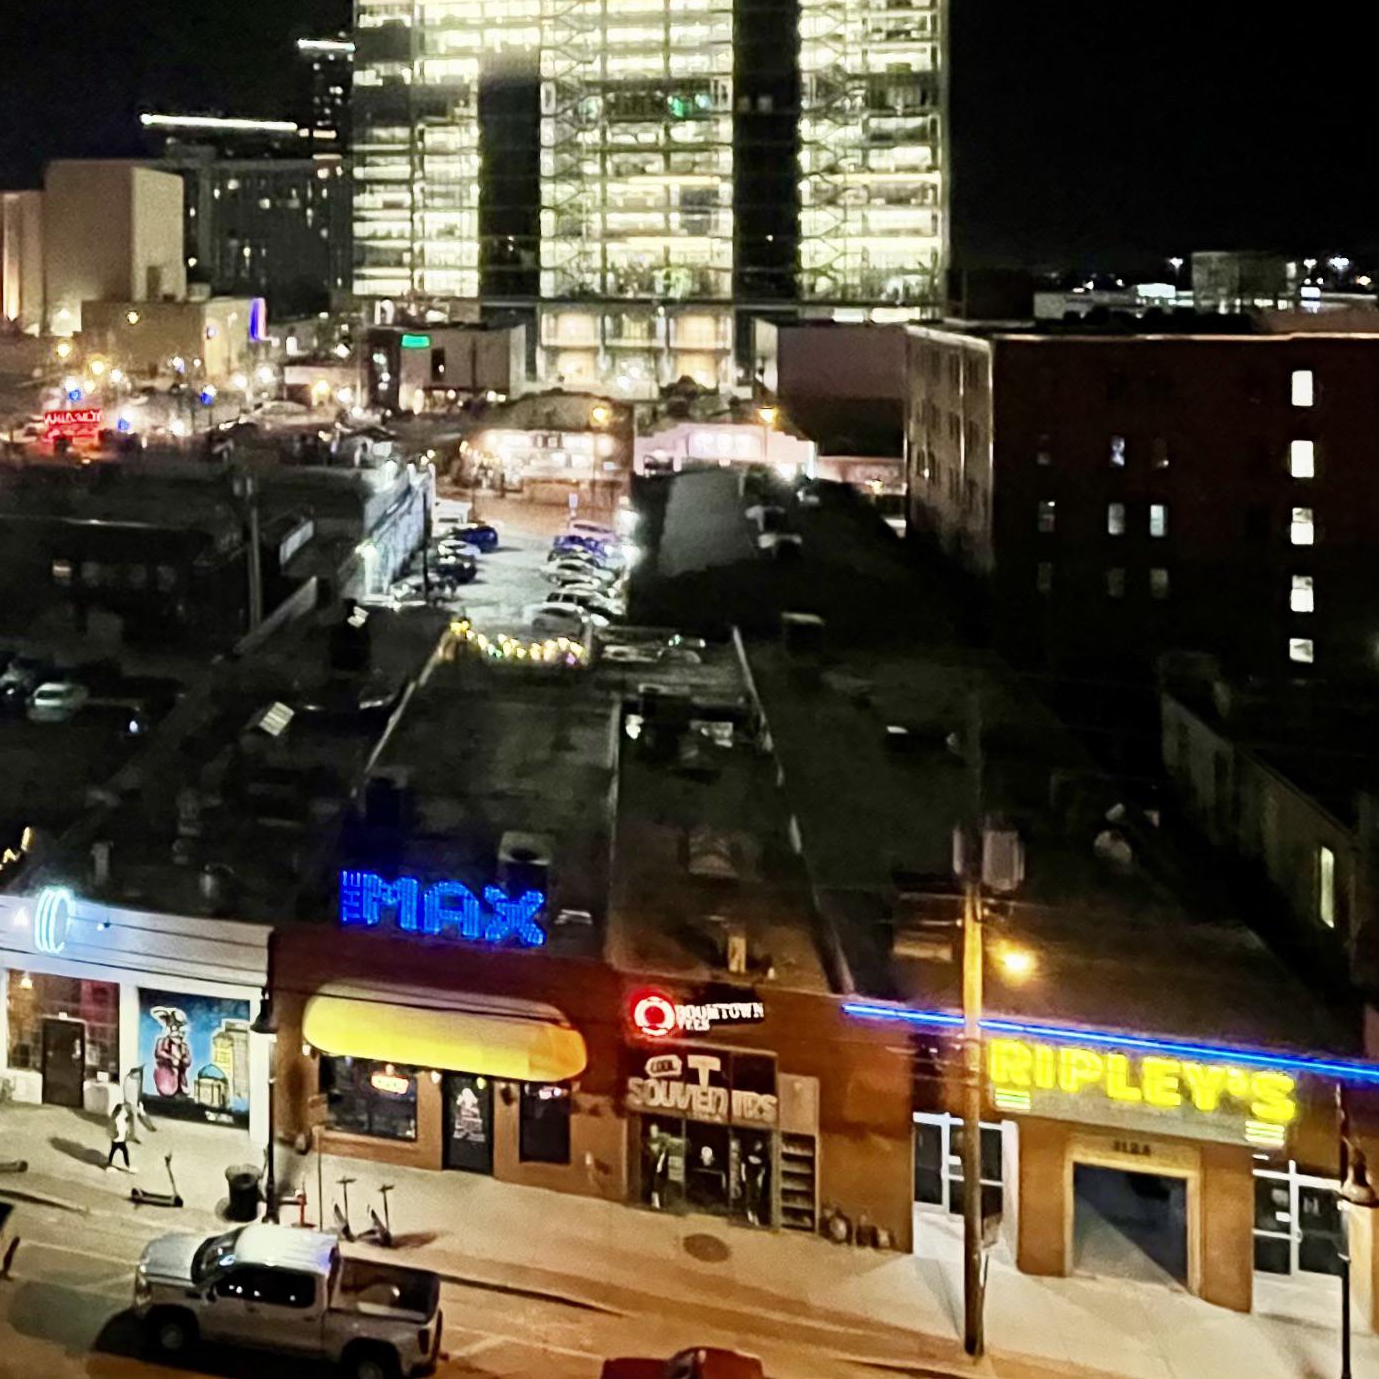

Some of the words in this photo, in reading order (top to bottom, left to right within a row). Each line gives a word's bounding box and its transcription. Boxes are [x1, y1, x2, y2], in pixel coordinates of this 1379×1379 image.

[342, 871, 361, 922] THE
[362, 873, 545, 946] MAX
[675, 1003, 765, 1020] BOOMTOWN
[988, 1038, 1297, 1122] RIPLEY'S
